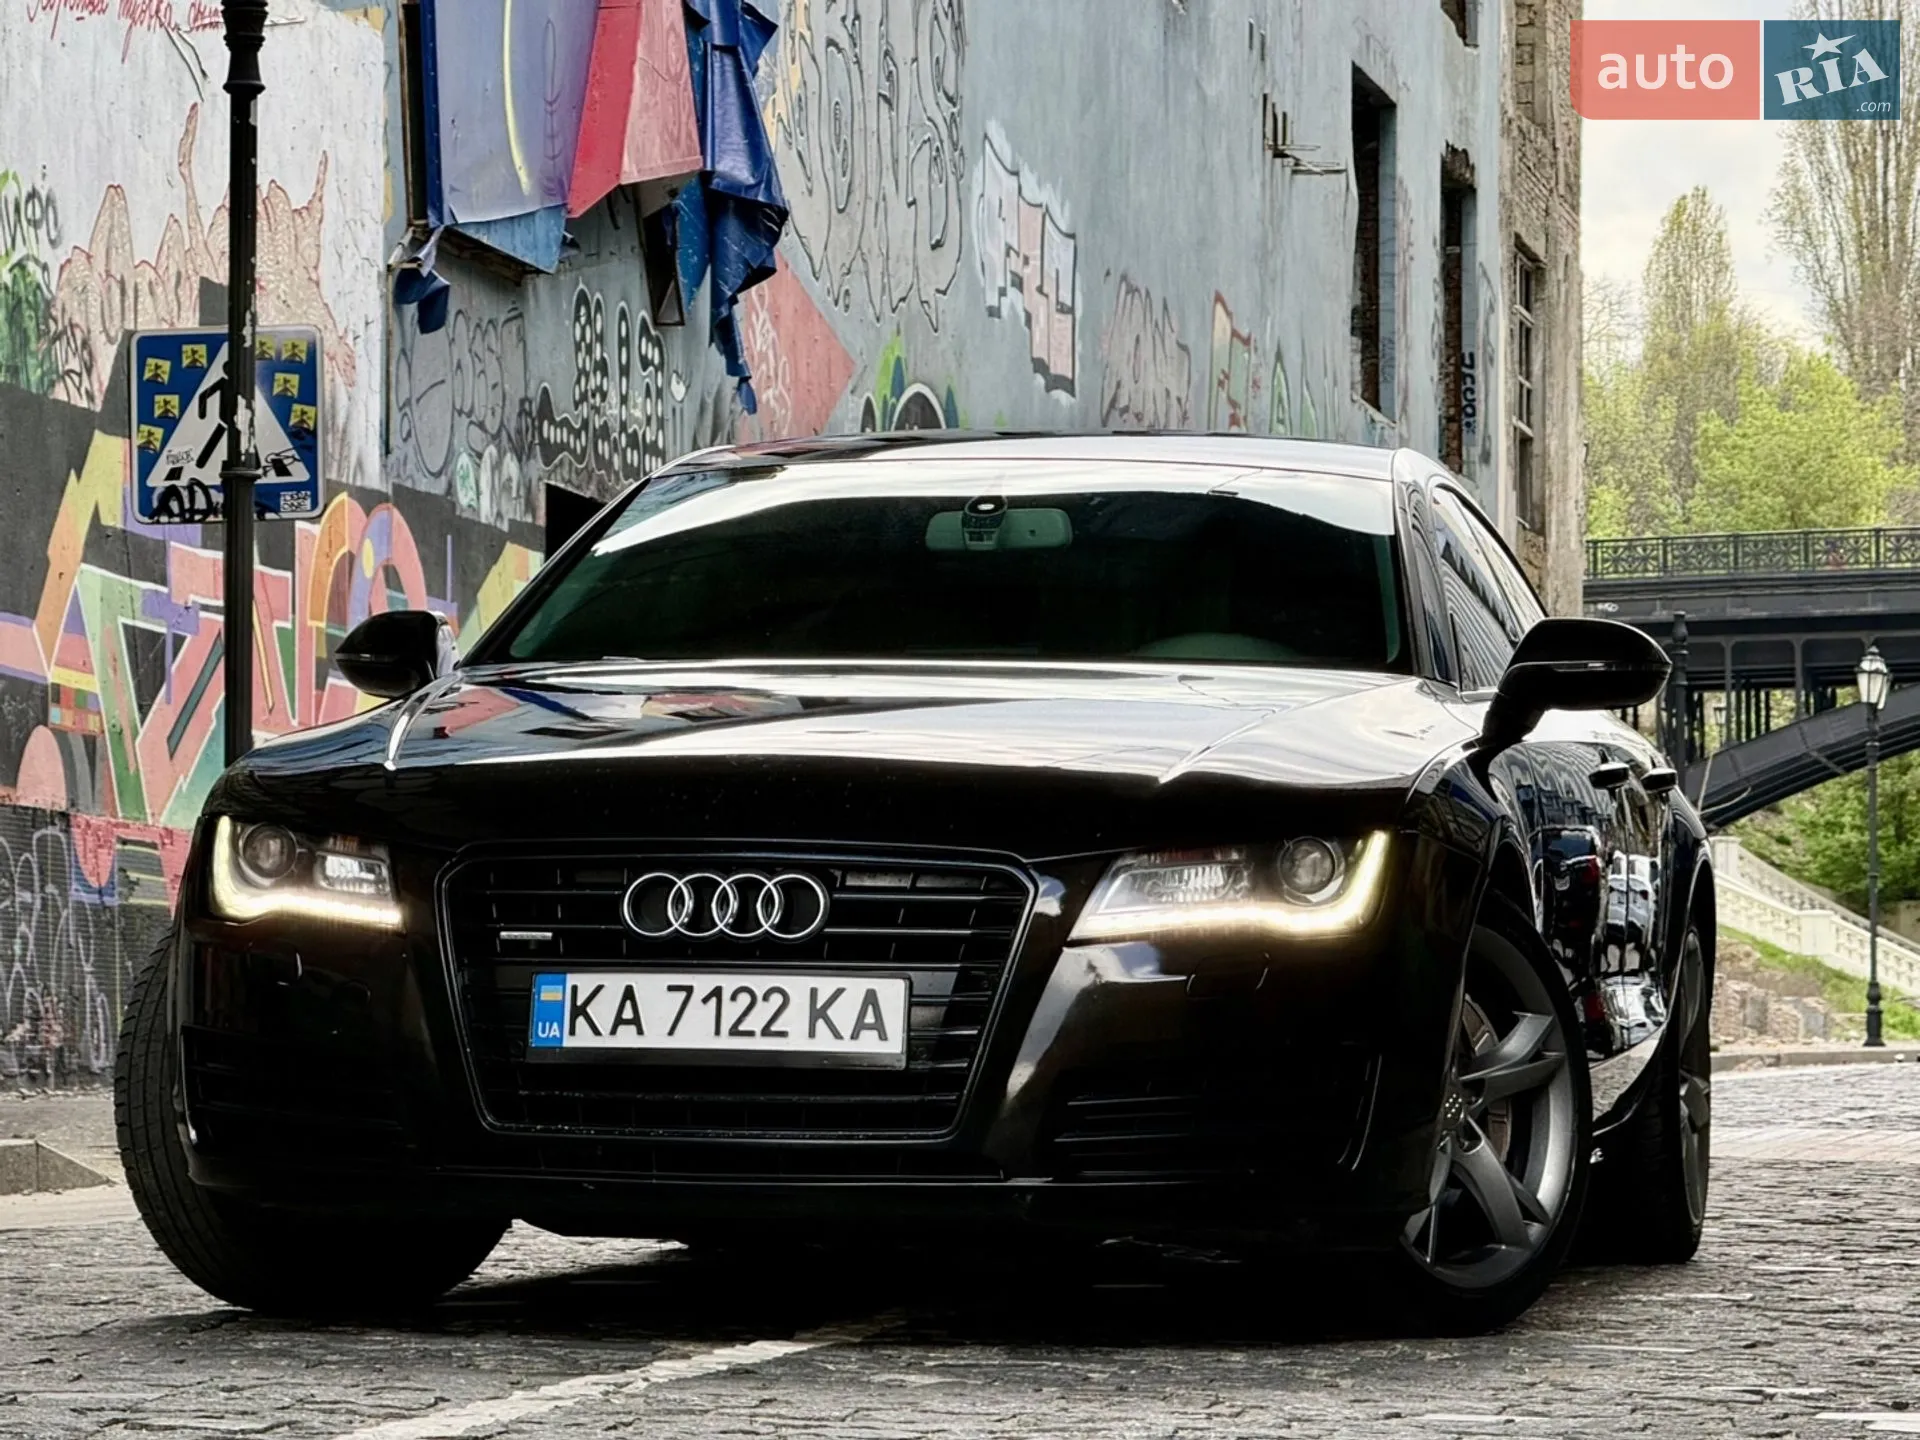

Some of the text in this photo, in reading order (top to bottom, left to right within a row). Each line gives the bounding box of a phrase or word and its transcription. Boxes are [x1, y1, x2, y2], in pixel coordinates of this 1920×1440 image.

[537, 983, 889, 1042] UA KA 7122 KA
